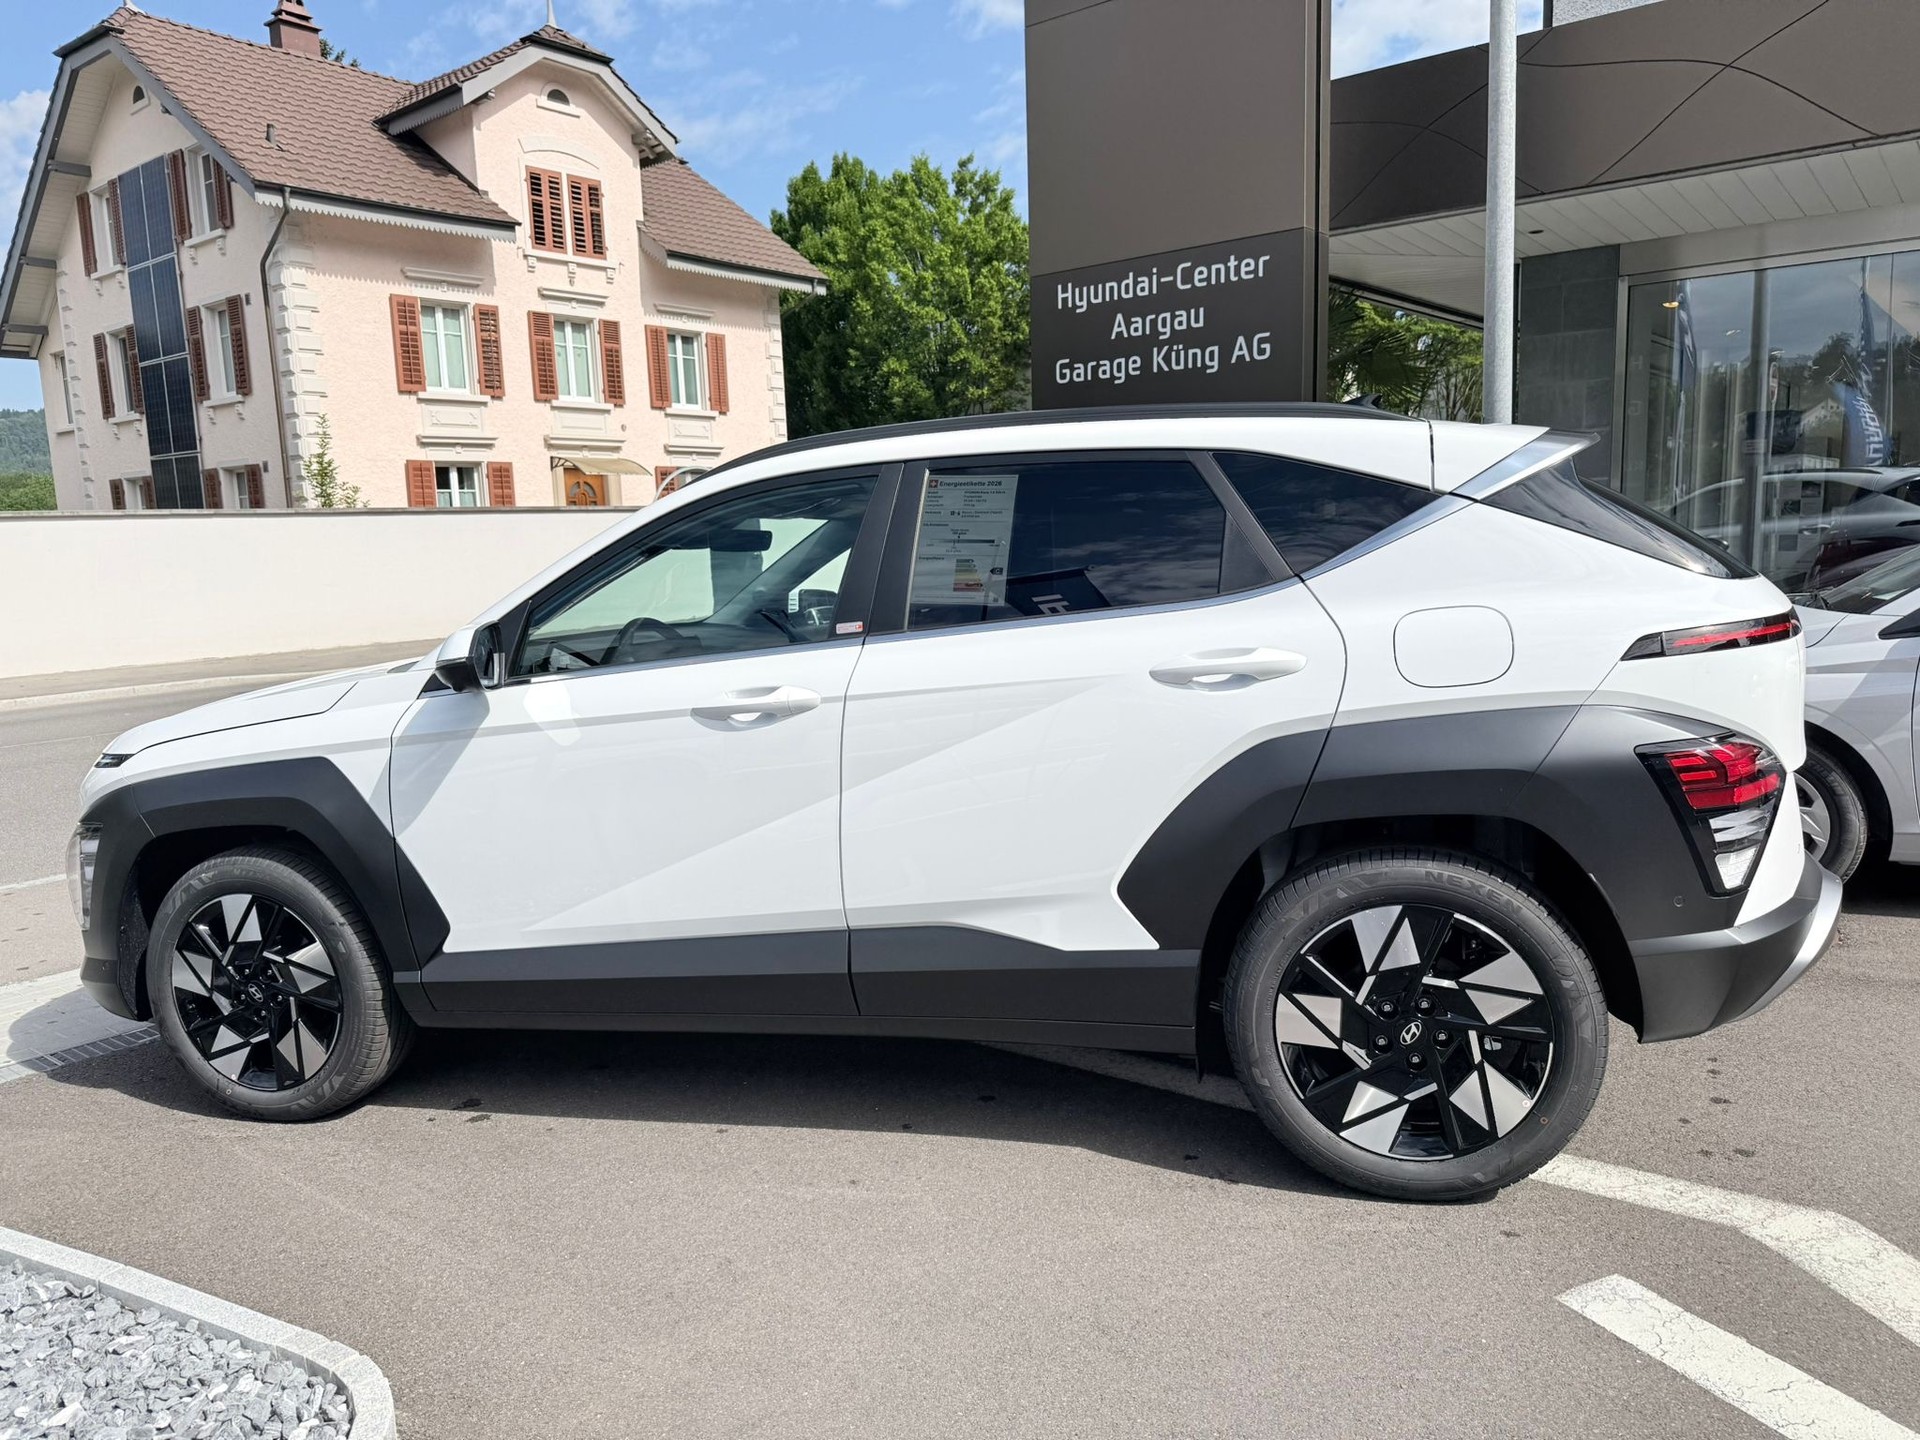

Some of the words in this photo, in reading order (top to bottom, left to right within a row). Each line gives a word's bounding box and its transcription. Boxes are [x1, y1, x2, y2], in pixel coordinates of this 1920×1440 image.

[1057, 254, 1271, 313] Hyundai-Center
[1110, 306, 1204, 340] Aargau
[1055, 354, 1142, 384] Garage
[1152, 344, 1219, 374] Küng
[1230, 331, 1271, 364] AG
[1424, 869, 1523, 915] NEXEN
